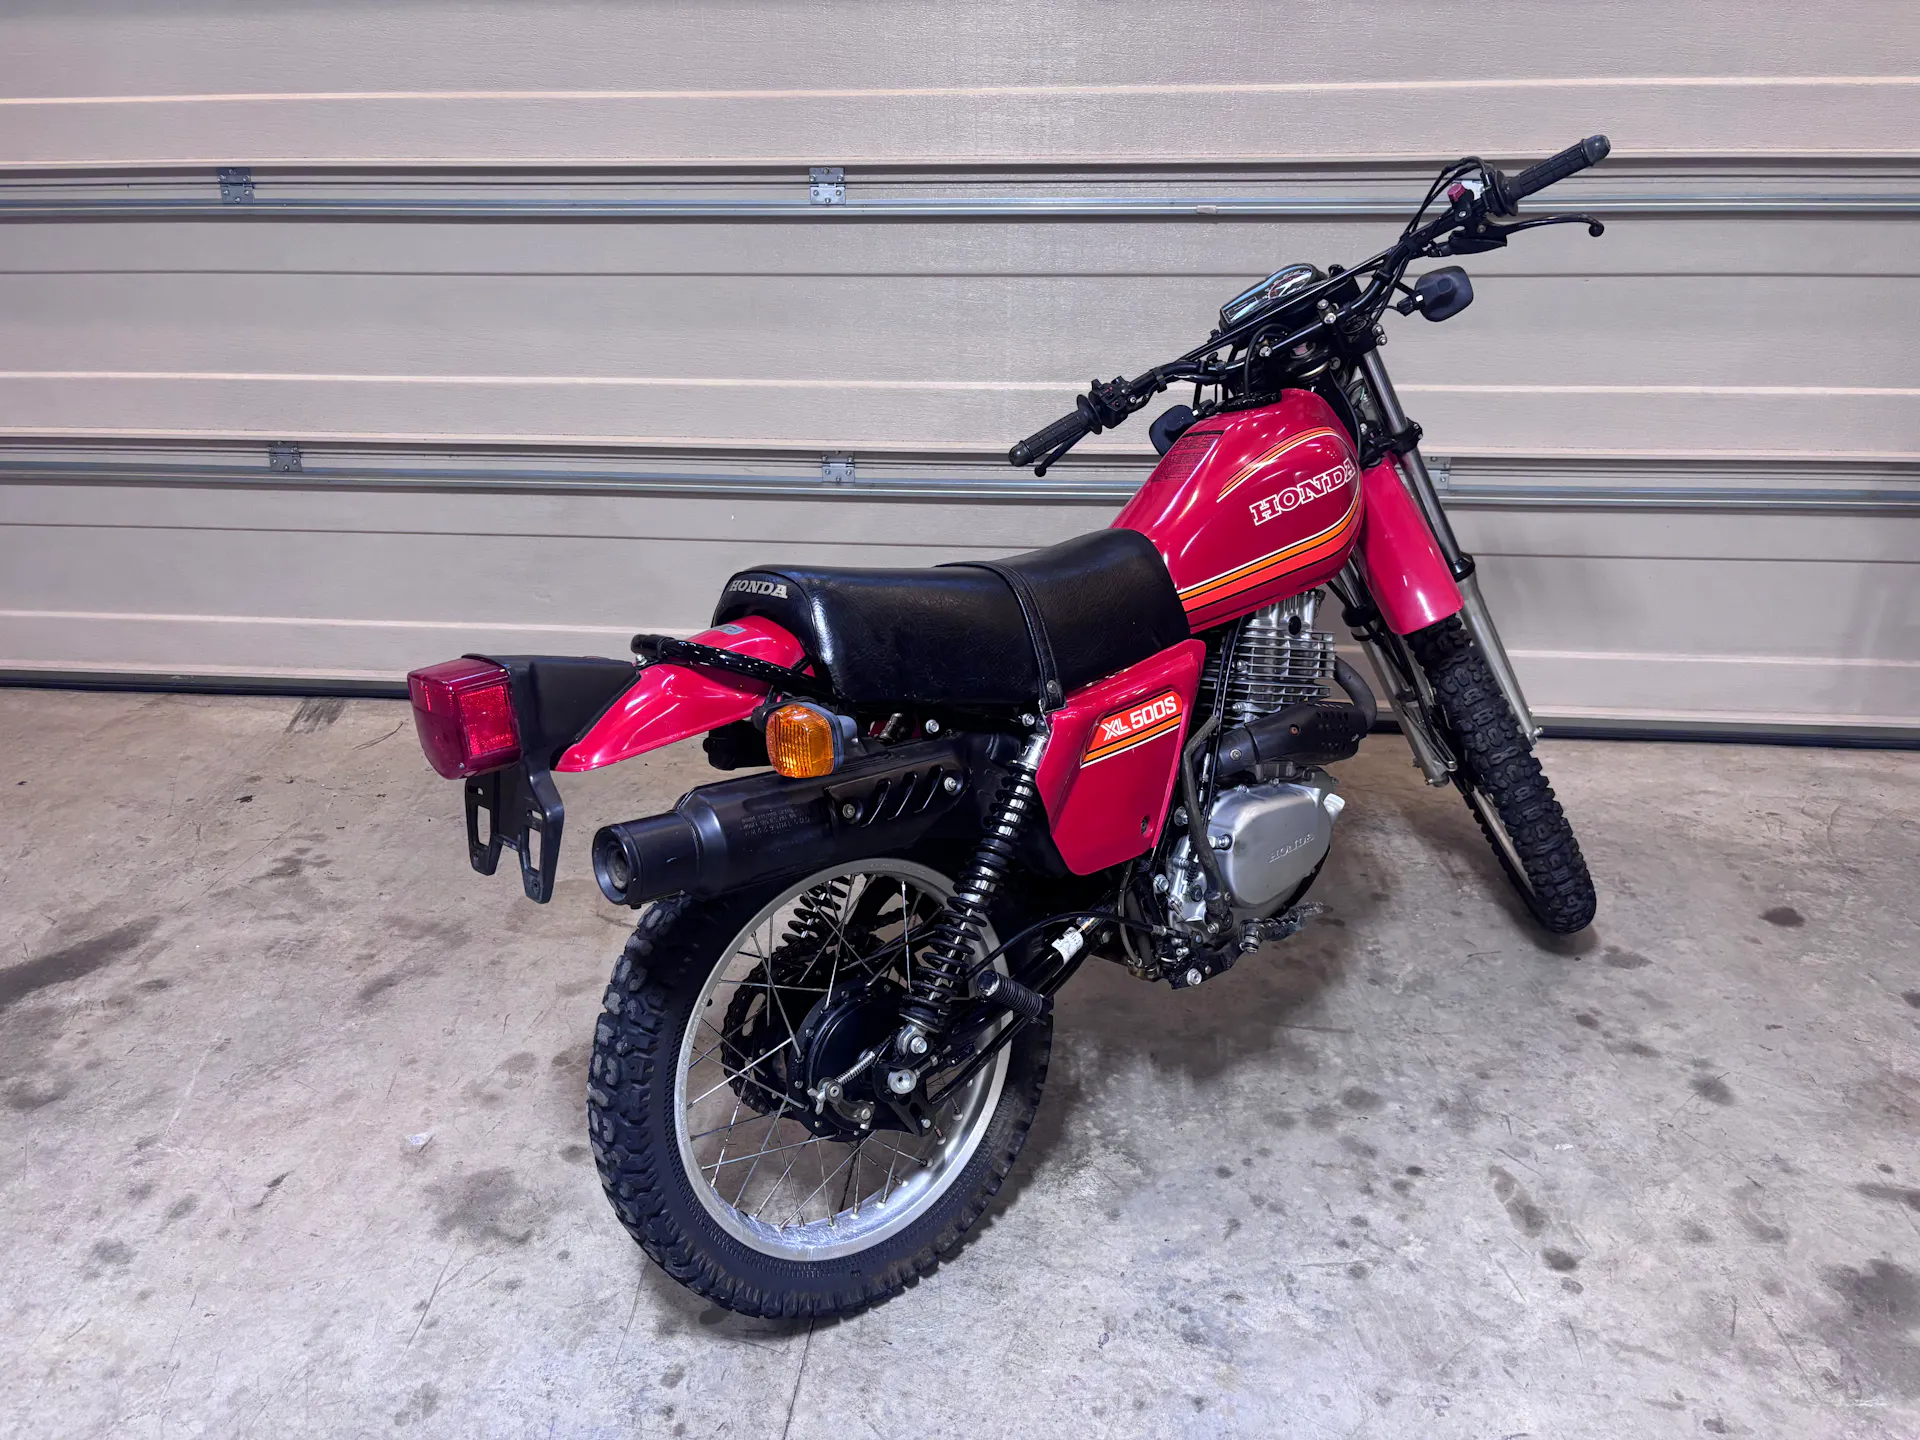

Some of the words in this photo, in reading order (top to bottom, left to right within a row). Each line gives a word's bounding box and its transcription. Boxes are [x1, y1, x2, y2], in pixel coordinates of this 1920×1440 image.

[1249, 457, 1356, 526] HONDA
[729, 579, 788, 599] HONDA
[1100, 718, 1132, 742] XL
[1129, 695, 1177, 730] 500S
[1268, 833, 1315, 864] HONDA
